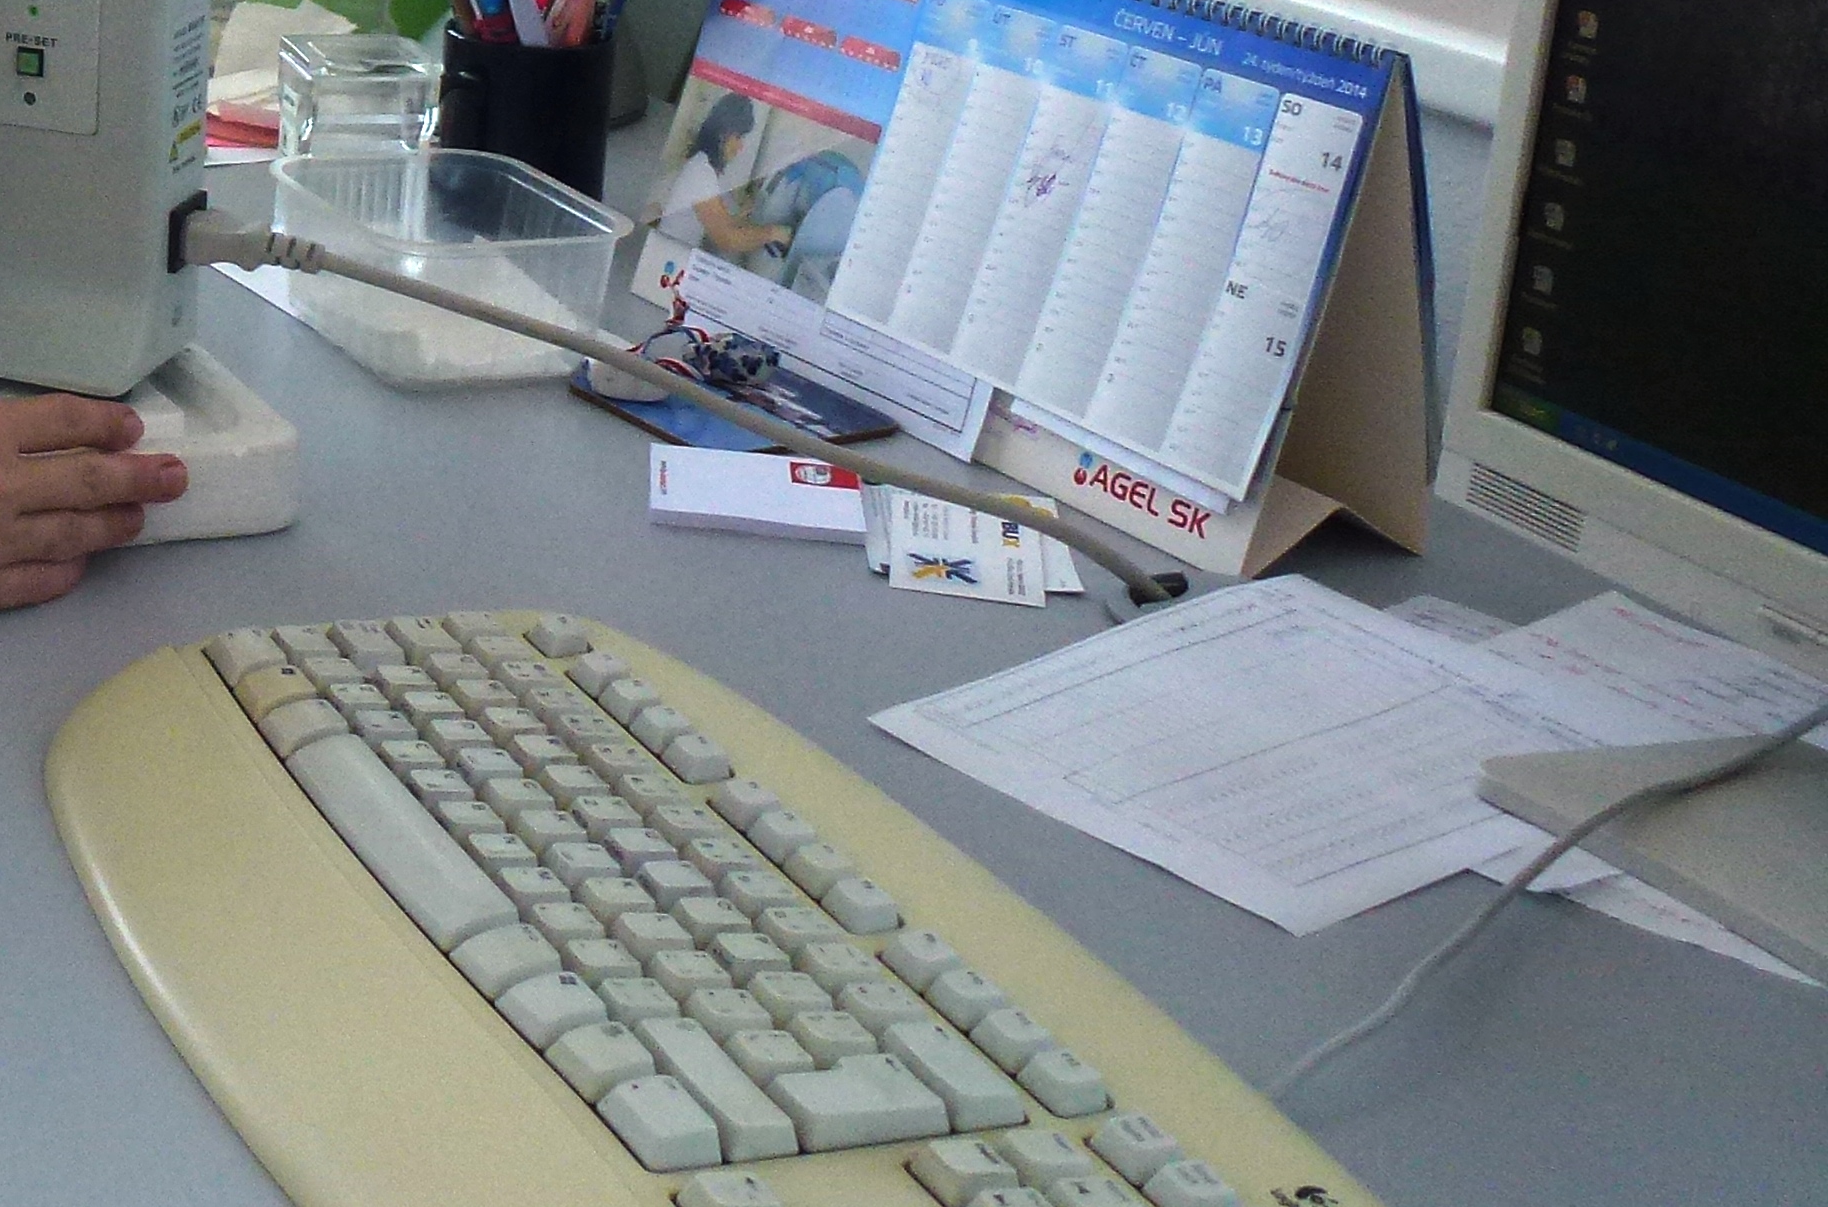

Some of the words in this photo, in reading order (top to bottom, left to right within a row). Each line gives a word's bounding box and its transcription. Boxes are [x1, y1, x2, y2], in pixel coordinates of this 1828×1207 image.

[5, 32, 59, 48] PRE-SET
[1336, 79, 1368, 99] 2014
[1280, 98, 1303, 117] SO
[1243, 125, 1264, 147] 13
[1321, 151, 1343, 172] 14
[1225, 280, 1249, 300] NE
[1265, 336, 1288, 358] 15
[1088, 463, 1160, 517] AGEL
[1166, 499, 1212, 540] SK
